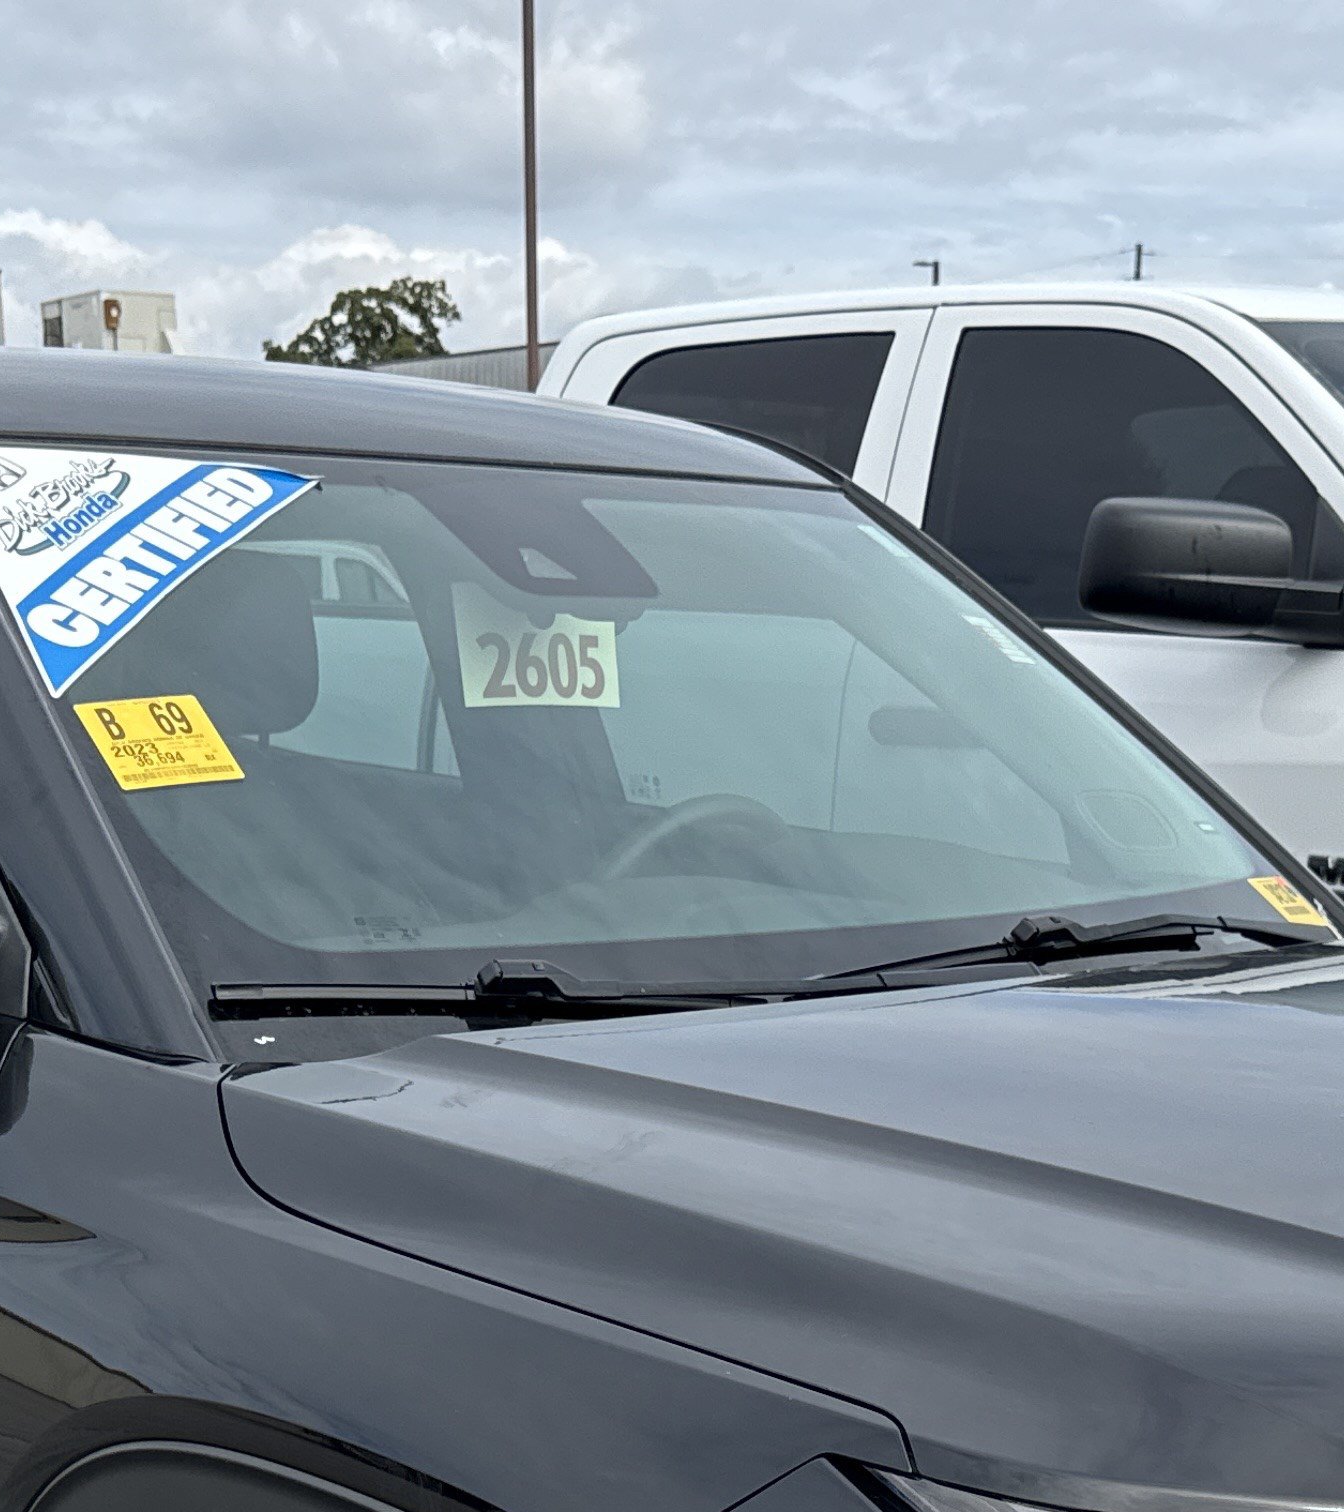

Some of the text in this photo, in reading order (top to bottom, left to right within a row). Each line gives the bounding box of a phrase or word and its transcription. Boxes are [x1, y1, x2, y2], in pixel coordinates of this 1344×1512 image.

[44, 493, 119, 546] Honda
[25, 467, 274, 648] CERTIFIED
[475, 632, 605, 699] 2605
[94, 701, 193, 741] B 69
[110, 742, 159, 758] 2023
[133, 749, 186, 768] 36,694
